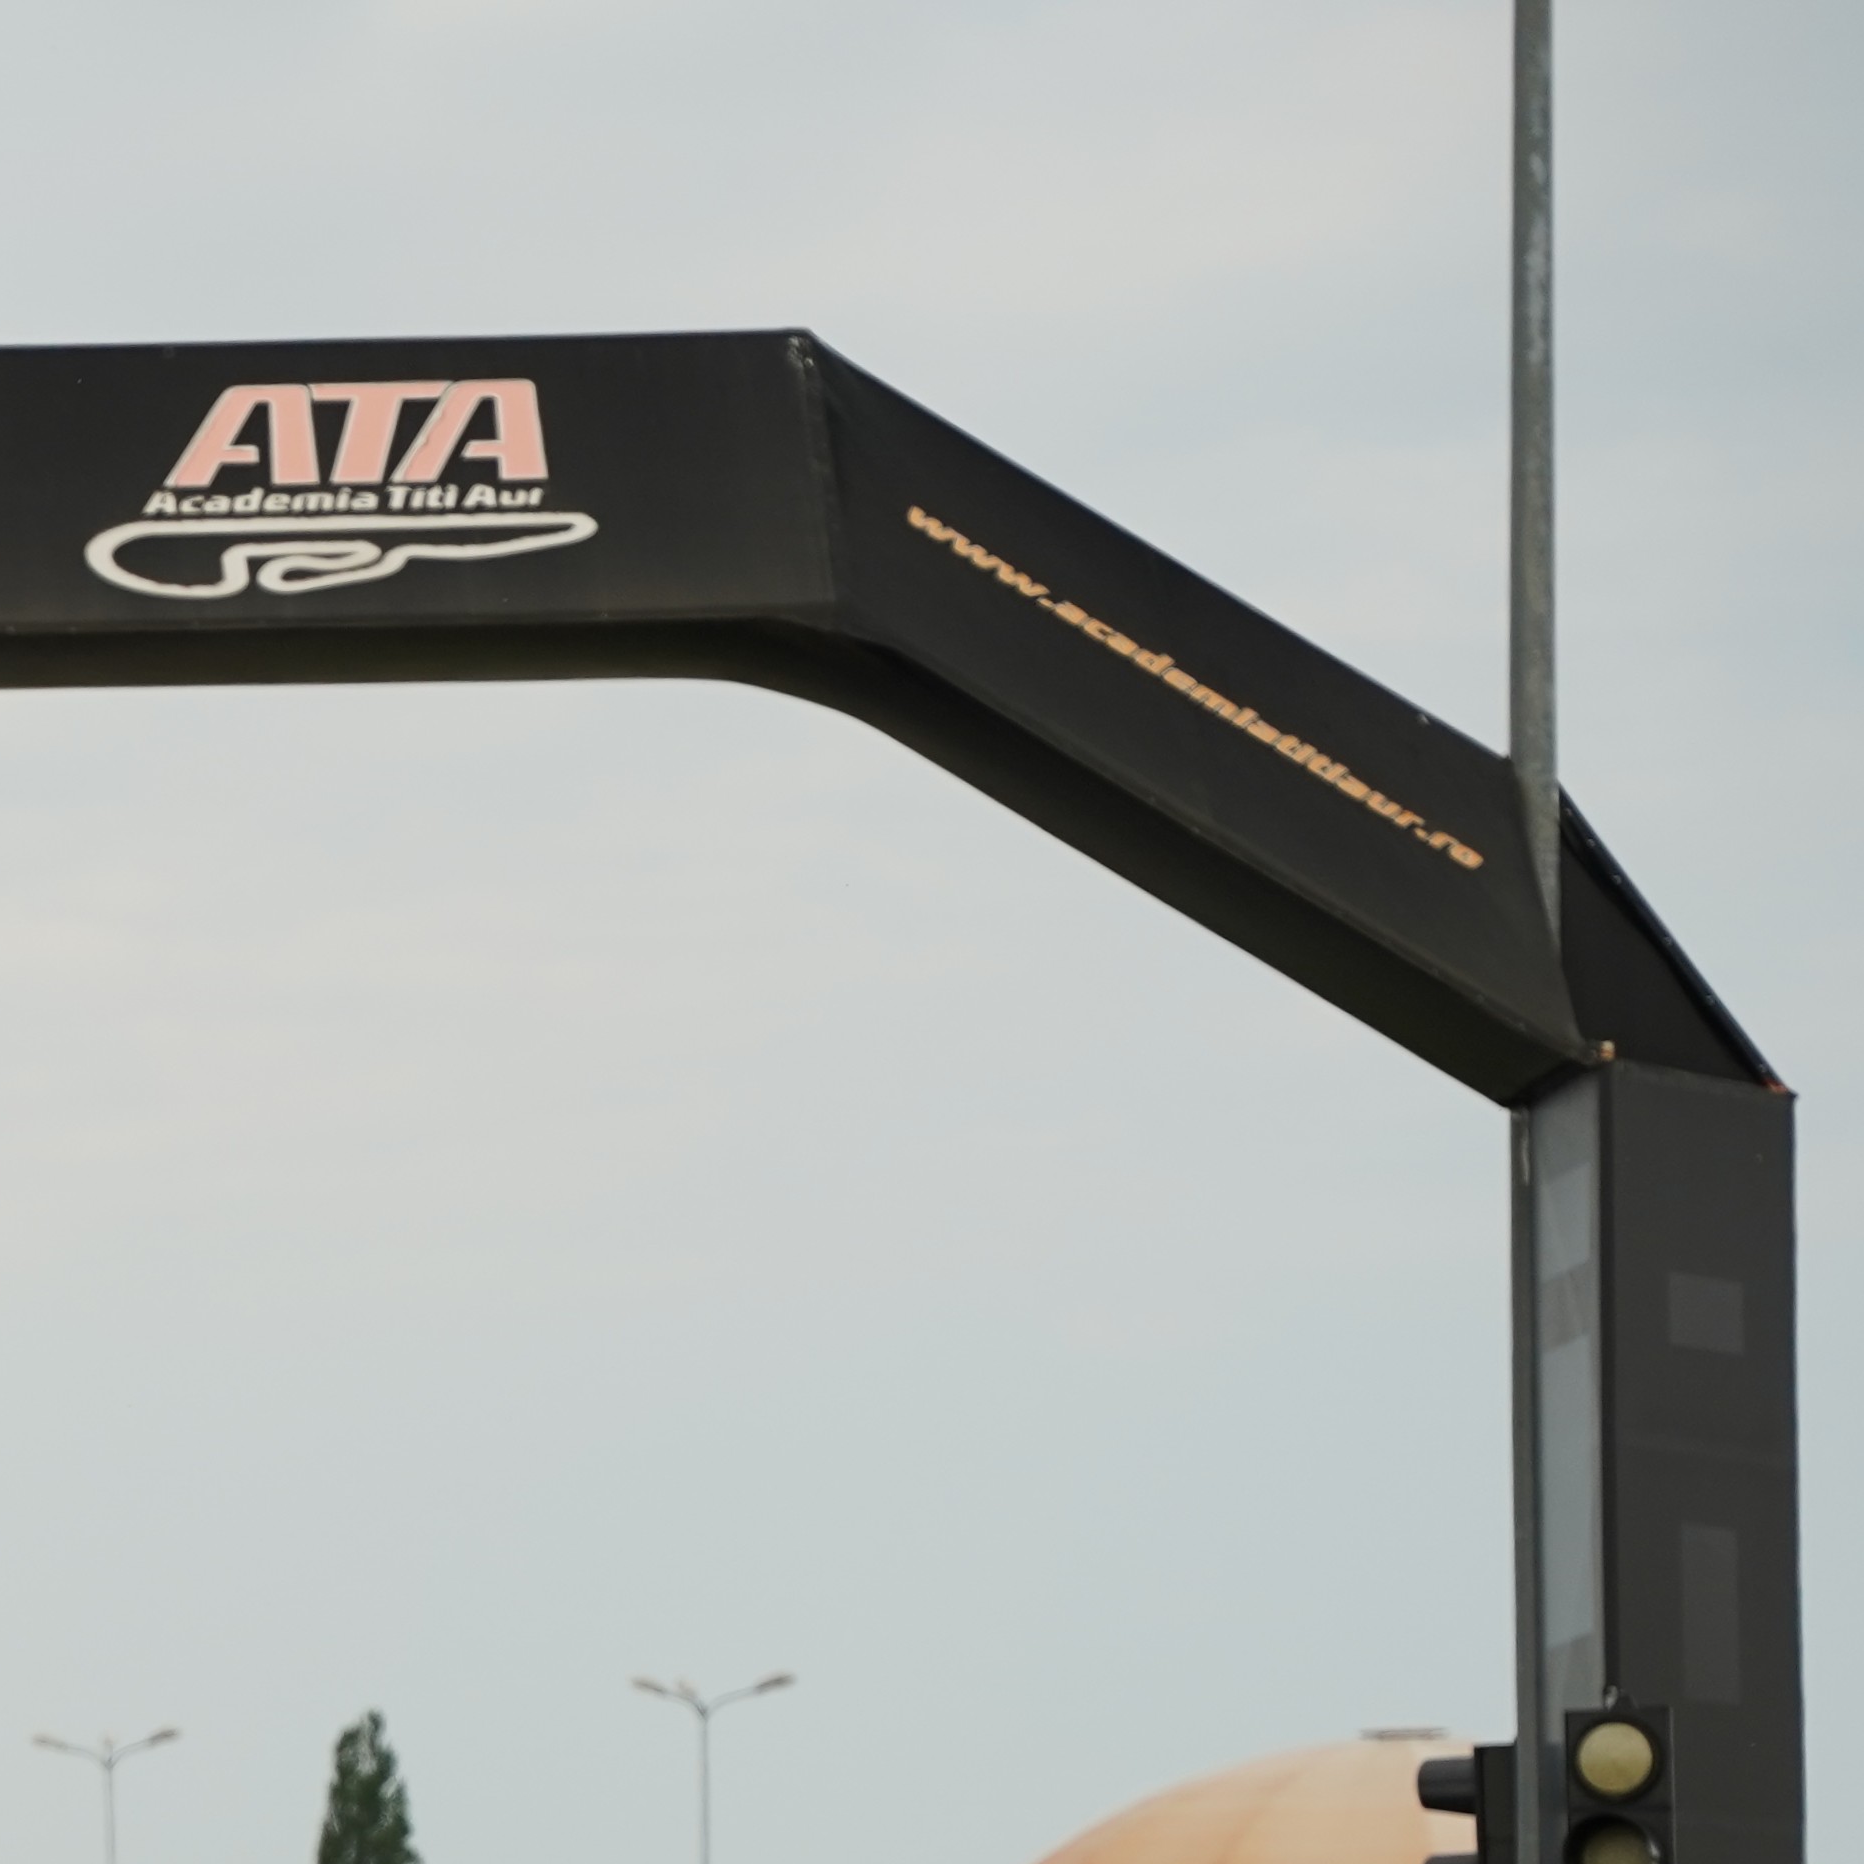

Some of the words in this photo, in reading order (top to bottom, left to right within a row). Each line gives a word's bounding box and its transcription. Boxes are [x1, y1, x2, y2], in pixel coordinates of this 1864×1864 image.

[163, 378, 549, 488] ATA
[141, 487, 379, 516] Academia
[386, 484, 460, 511] Titi
[459, 483, 545, 509] Aur
[906, 505, 1485, 870] www.academiatitiaur.ro
